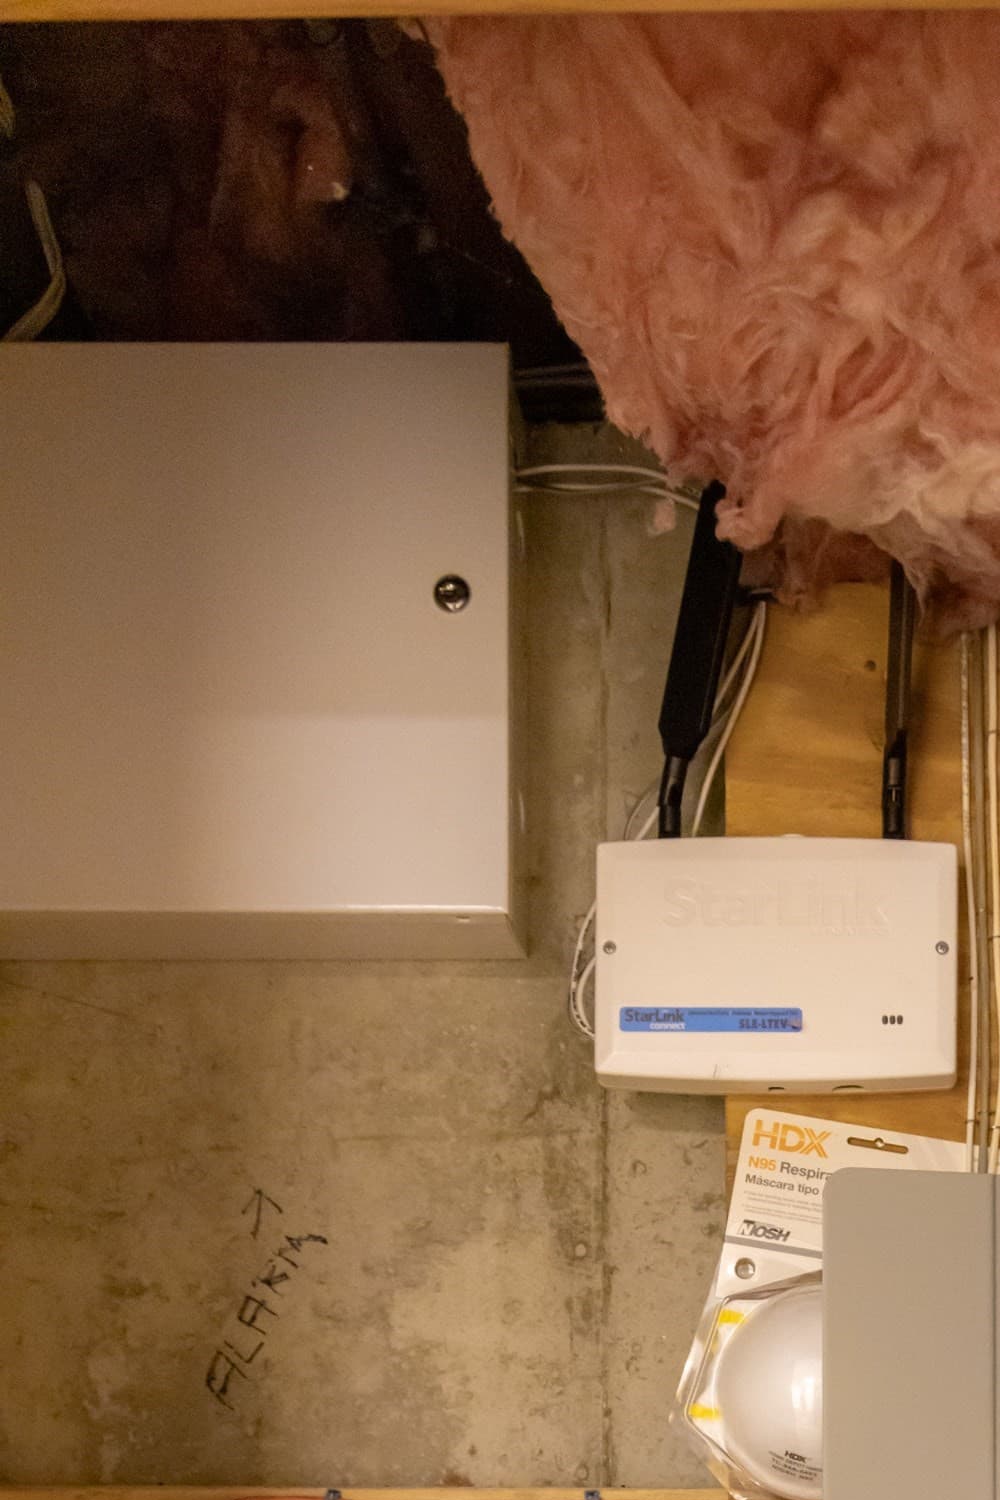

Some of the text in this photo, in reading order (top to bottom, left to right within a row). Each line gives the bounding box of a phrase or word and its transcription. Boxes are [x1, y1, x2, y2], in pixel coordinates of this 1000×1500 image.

[663, 876, 889, 928] StarLink
[624, 1008, 684, 1022] StarLink
[752, 1119, 831, 1158] HDX
[748, 1155, 777, 1171] N95
[798, 1183, 820, 1195] tipo
[737, 1219, 791, 1241] NIOSH
